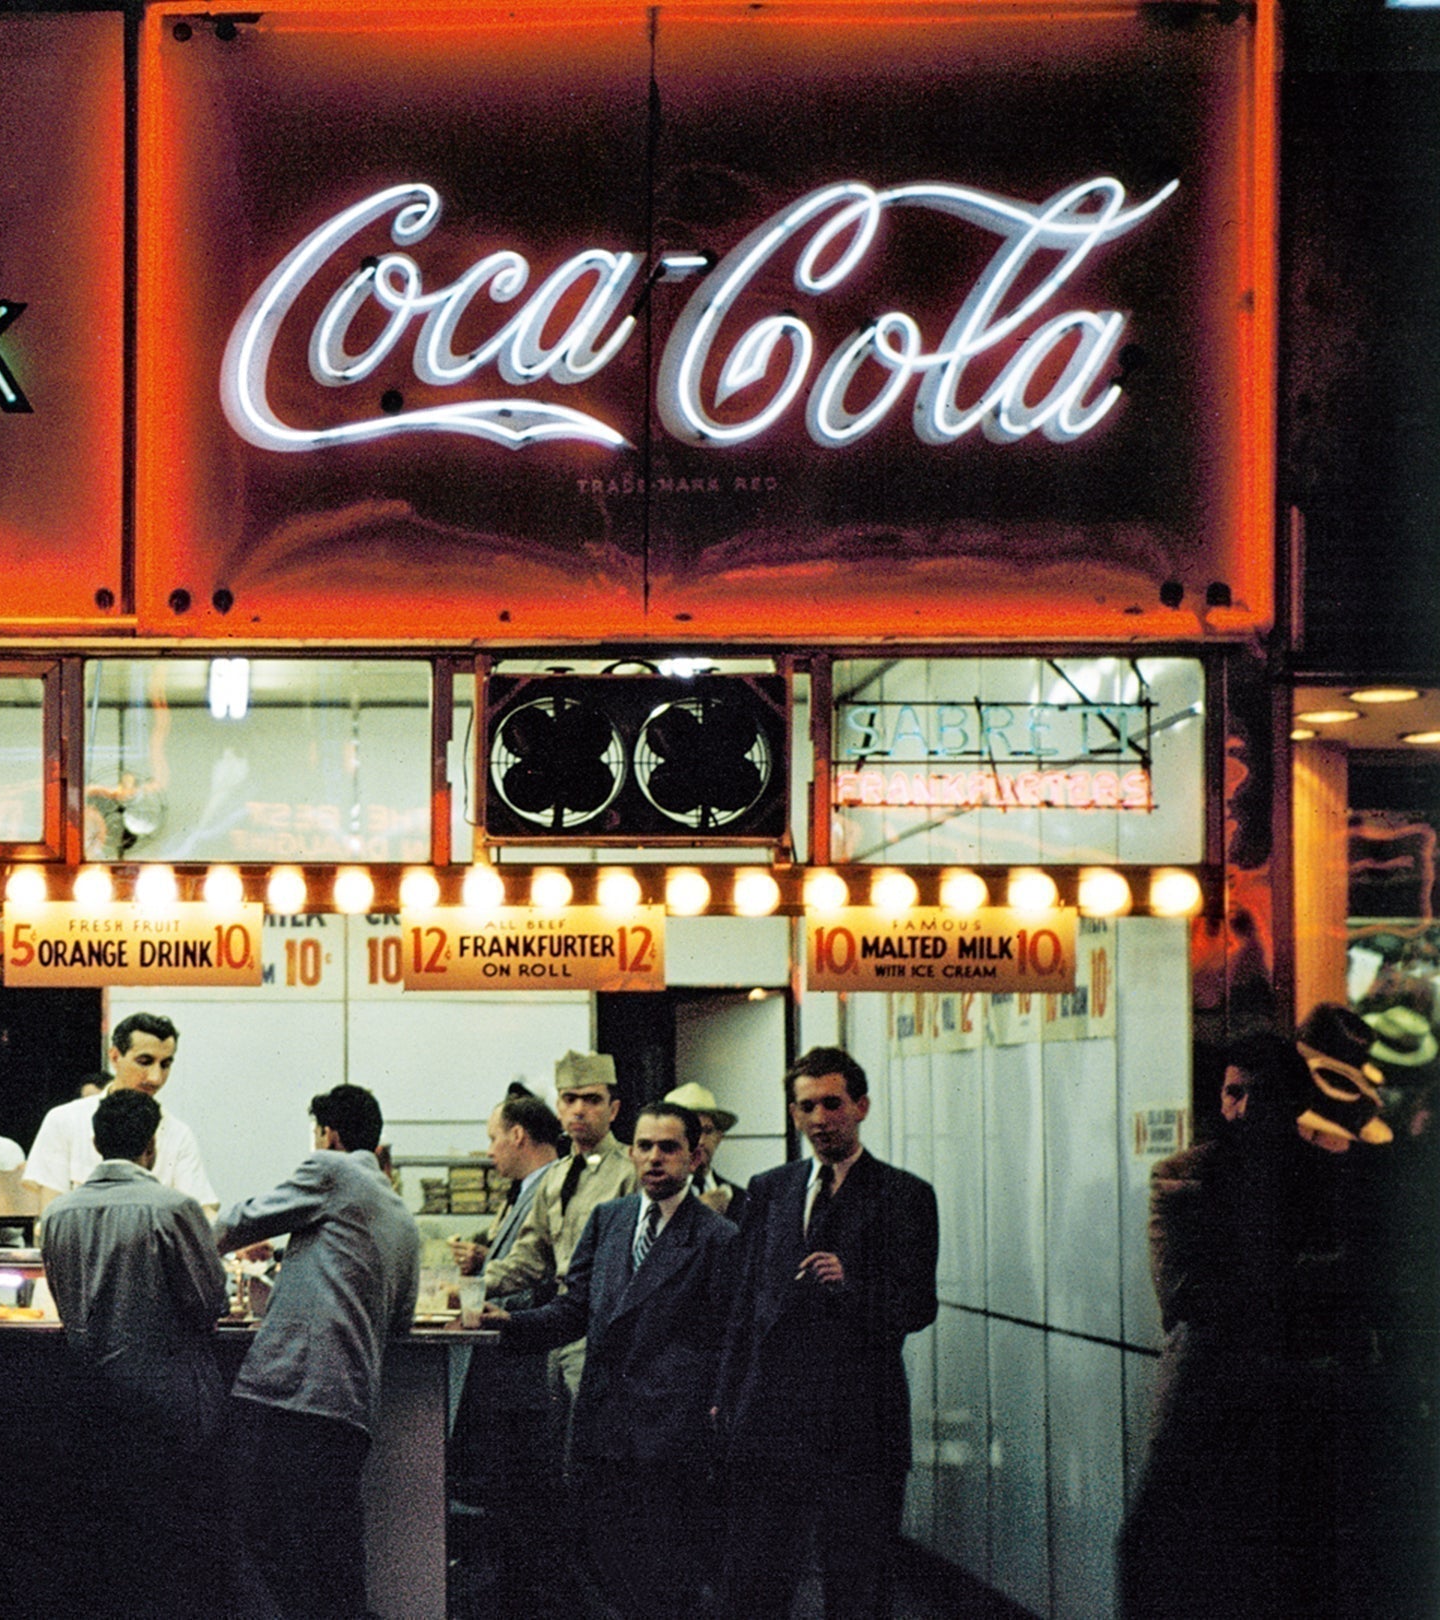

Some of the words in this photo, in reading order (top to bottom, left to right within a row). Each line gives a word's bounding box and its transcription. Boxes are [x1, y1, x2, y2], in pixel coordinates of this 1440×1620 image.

[220, 176, 1179, 452] Coca-Cola
[847, 705, 1145, 757] SABRETT
[836, 770, 1151, 806] FRANKFURTERS
[68, 920, 124, 933] FRESH
[133, 920, 180, 933] FRUIT
[485, 920, 516, 930] ALL
[38, 939, 128, 968] ORANGE
[140, 939, 213, 968] DRINK
[458, 935, 615, 958] FRANKFURTER
[862, 936, 947, 960] MALTED
[958, 936, 1013, 961] MILK
[482, 964, 512, 977] ON
[518, 963, 572, 977] ROLL
[875, 965, 906, 978] WITH
[911, 964, 935, 978] ICE
[942, 964, 997, 979] CREAM
